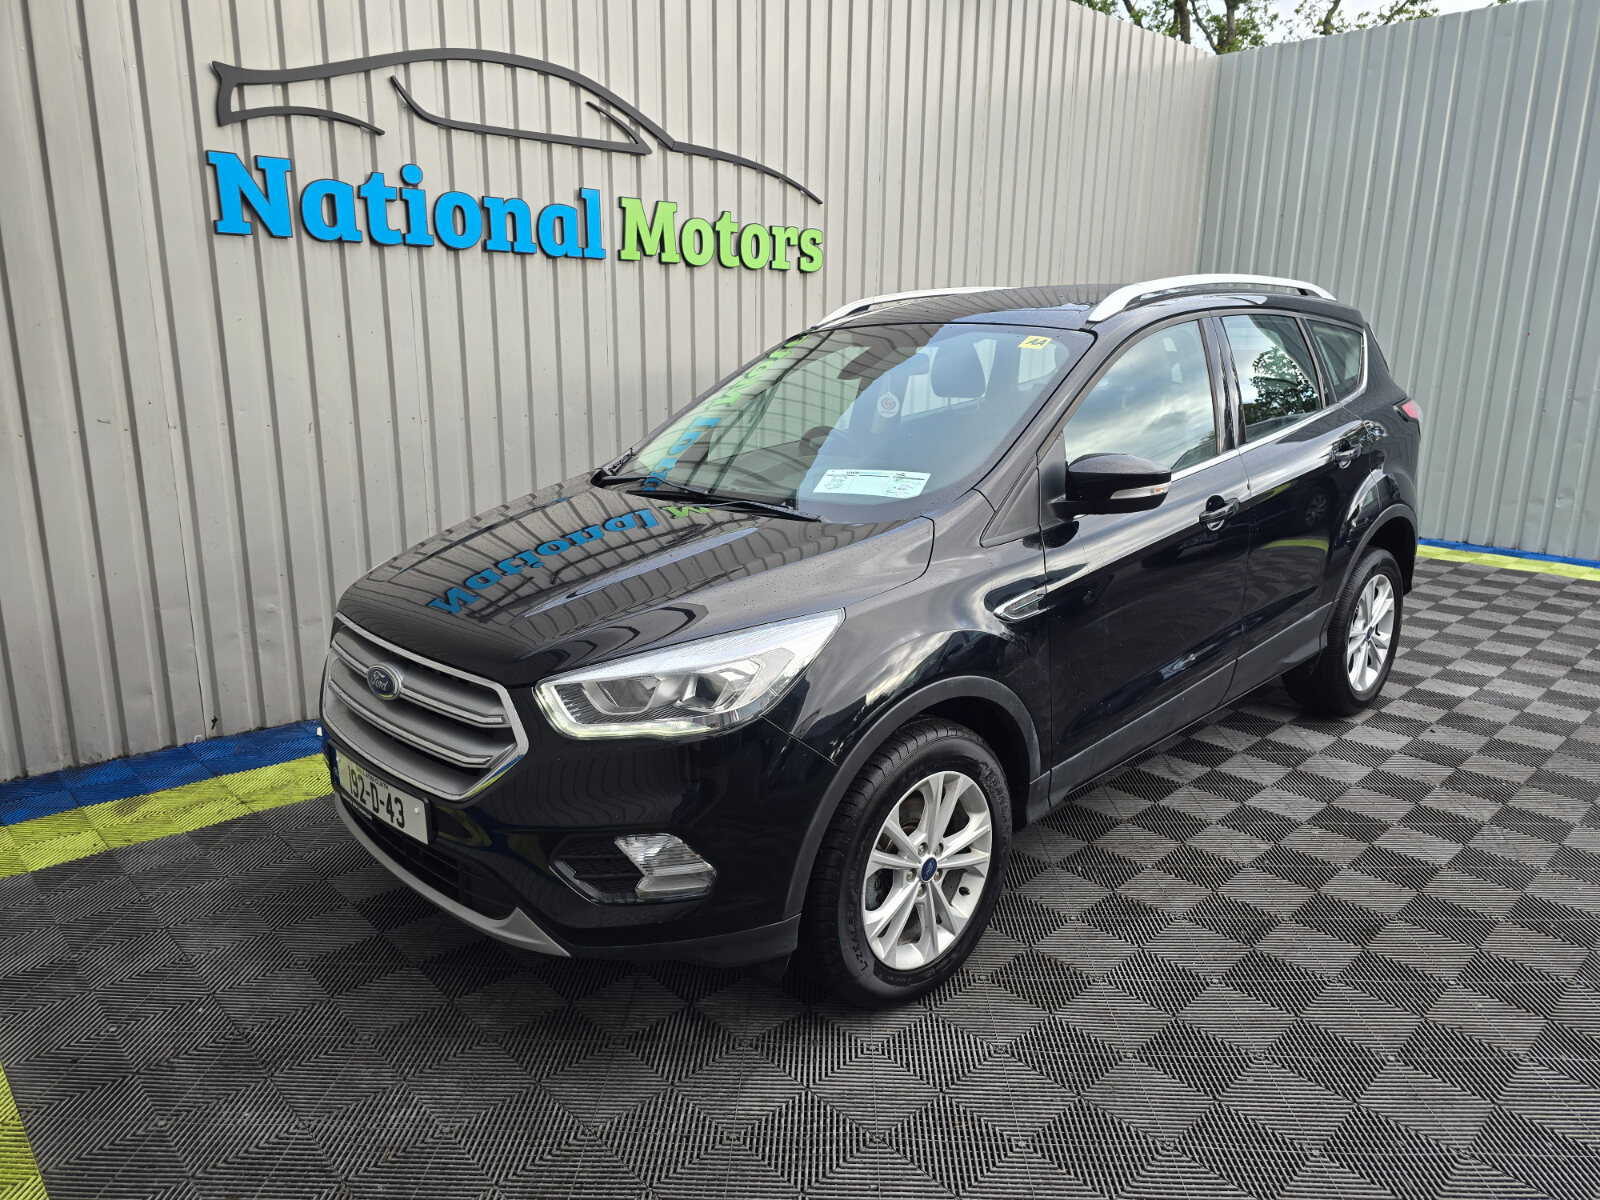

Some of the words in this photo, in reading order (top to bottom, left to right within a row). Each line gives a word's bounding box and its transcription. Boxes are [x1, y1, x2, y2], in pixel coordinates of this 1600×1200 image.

[206, 150, 606, 259] National
[618, 197, 825, 273] Motors
[1025, 337, 1048, 347] AA
[371, 671, 389, 692] Ford
[347, 764, 405, 829] 192-D-43
